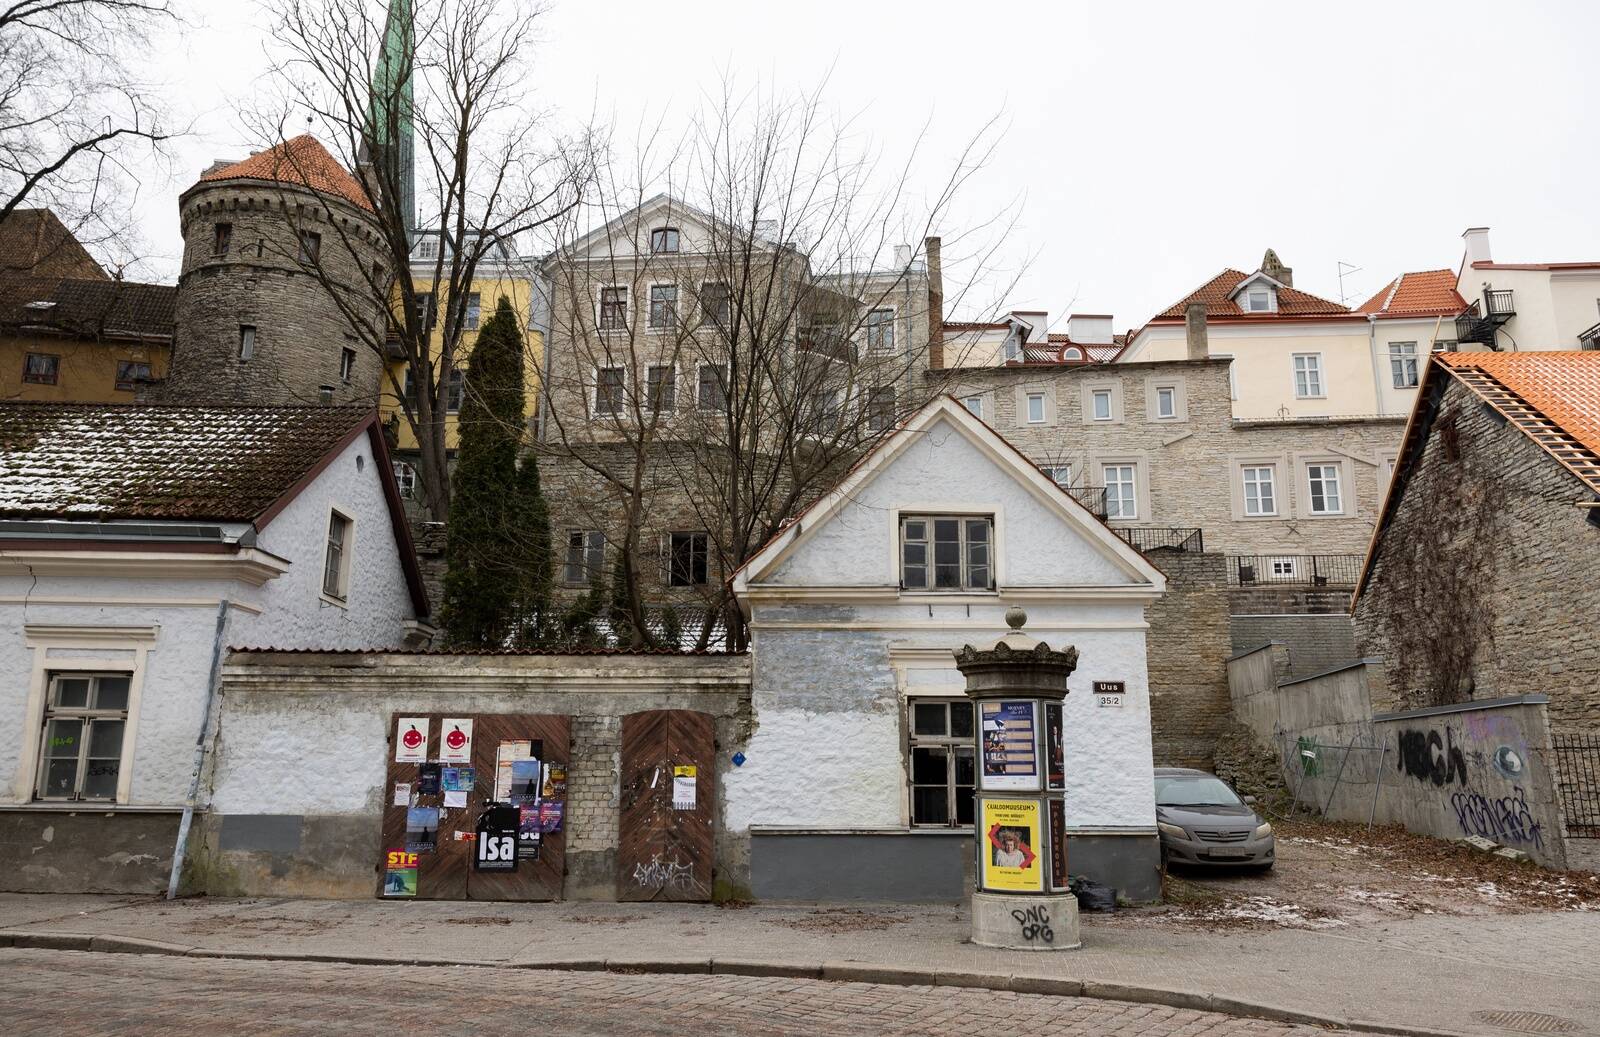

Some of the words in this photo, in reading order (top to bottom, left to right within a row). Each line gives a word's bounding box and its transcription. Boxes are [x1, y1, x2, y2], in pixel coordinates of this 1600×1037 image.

[479, 831, 514, 860] Isa
[388, 851, 418, 864] STF
[1011, 905, 1049, 926] DNC
